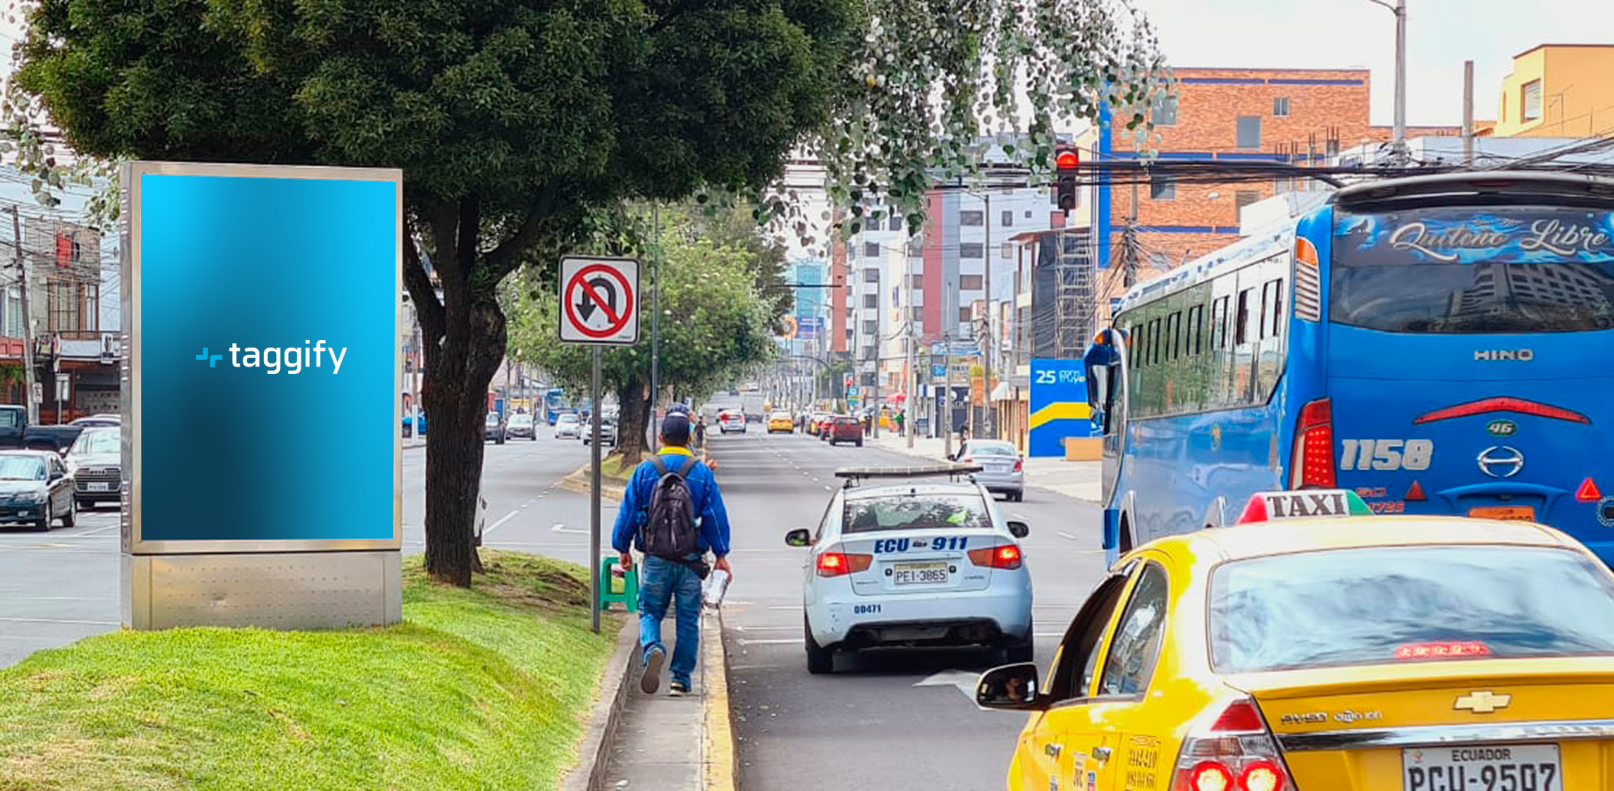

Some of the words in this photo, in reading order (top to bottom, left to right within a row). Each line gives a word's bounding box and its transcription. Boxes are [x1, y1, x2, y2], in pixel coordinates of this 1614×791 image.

[1519, 218, 1609, 256] Libre
[229, 339, 348, 375] taggify
[1473, 348, 1534, 362] HINO
[1035, 370, 1056, 384] 25
[1487, 422, 1513, 434] 46
[1340, 439, 1433, 471] 1158
[1267, 493, 1347, 518] TAXI
[874, 537, 911, 554] ECU
[931, 536, 968, 551] 911
[854, 604, 882, 614] 00471
[1451, 749, 1511, 762] ECUADOR
